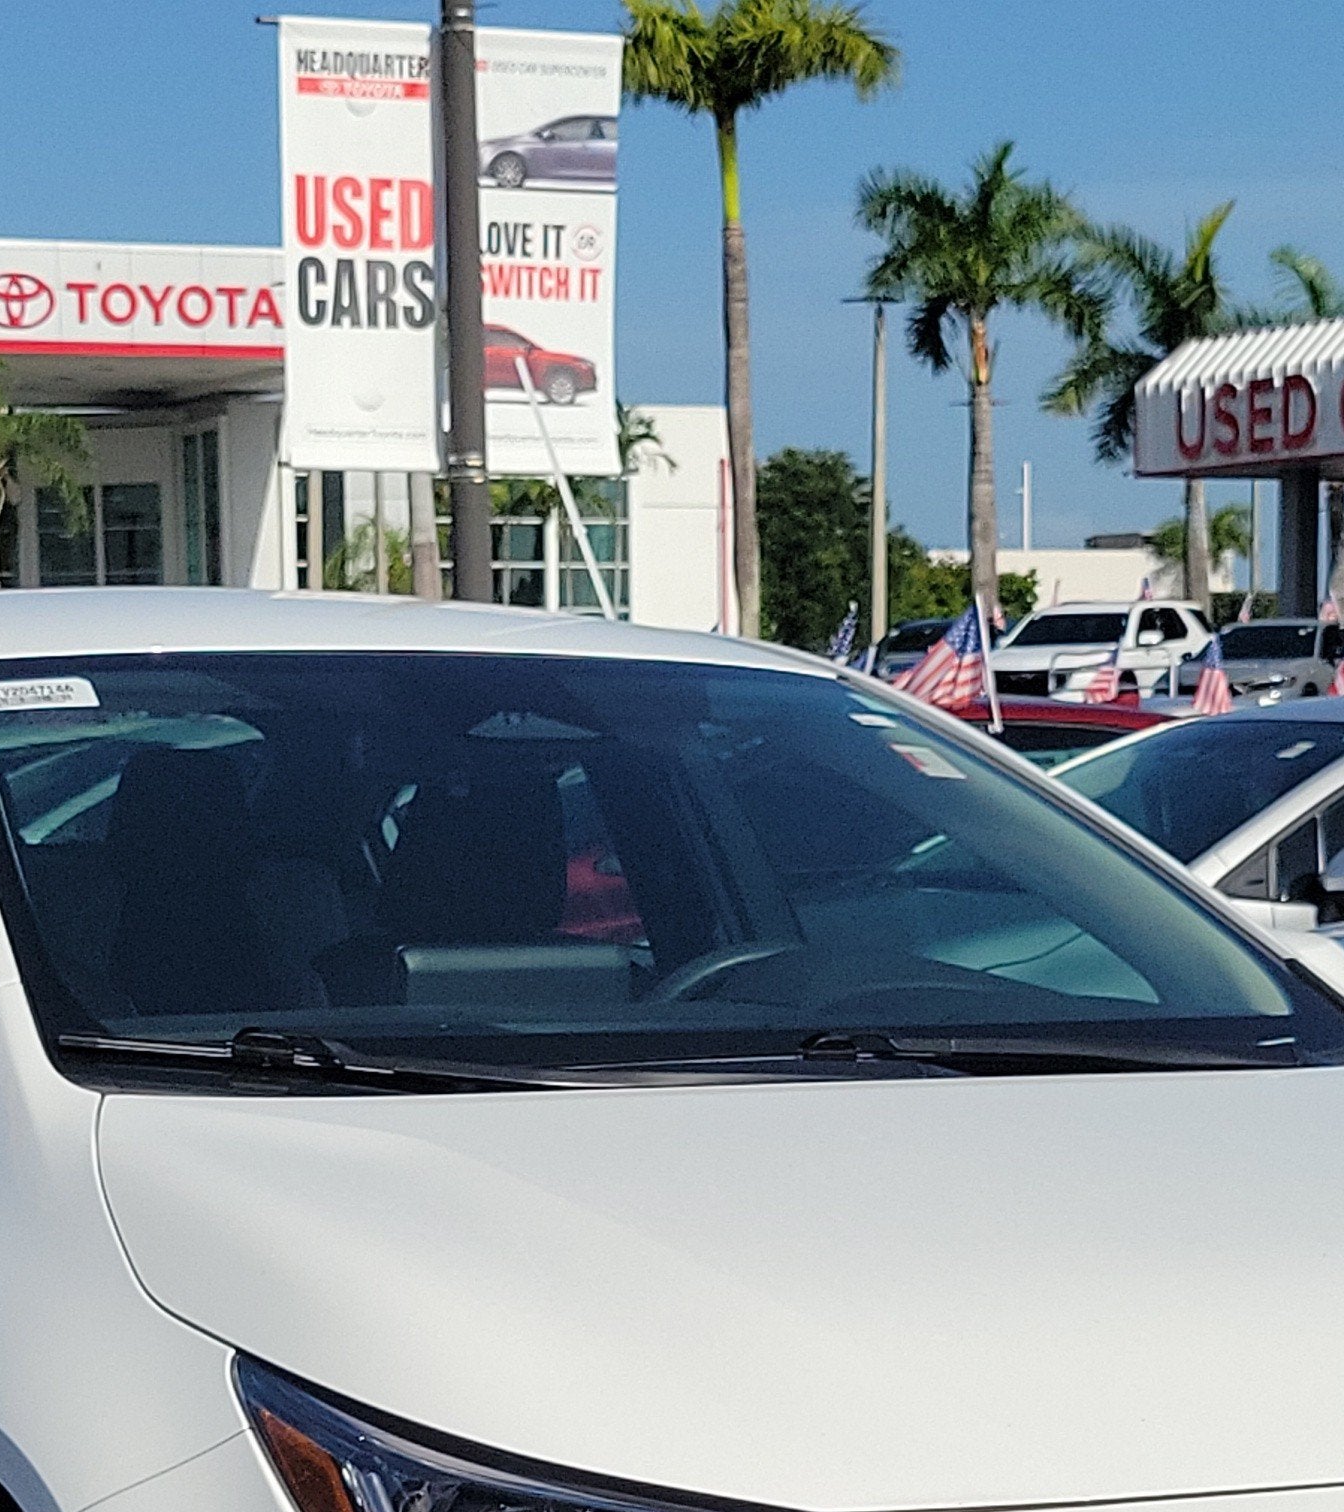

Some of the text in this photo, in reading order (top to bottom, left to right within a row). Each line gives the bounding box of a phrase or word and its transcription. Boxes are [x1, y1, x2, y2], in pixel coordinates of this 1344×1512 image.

[296, 49, 430, 80] HEADQUARTER
[295, 174, 434, 250] USED
[480, 221, 532, 257] OVE
[542, 224, 566, 259] IT
[65, 282, 284, 330] TOYOTA
[298, 256, 436, 329] CARS
[580, 267, 602, 301] IT
[1175, 374, 1318, 461] USED
